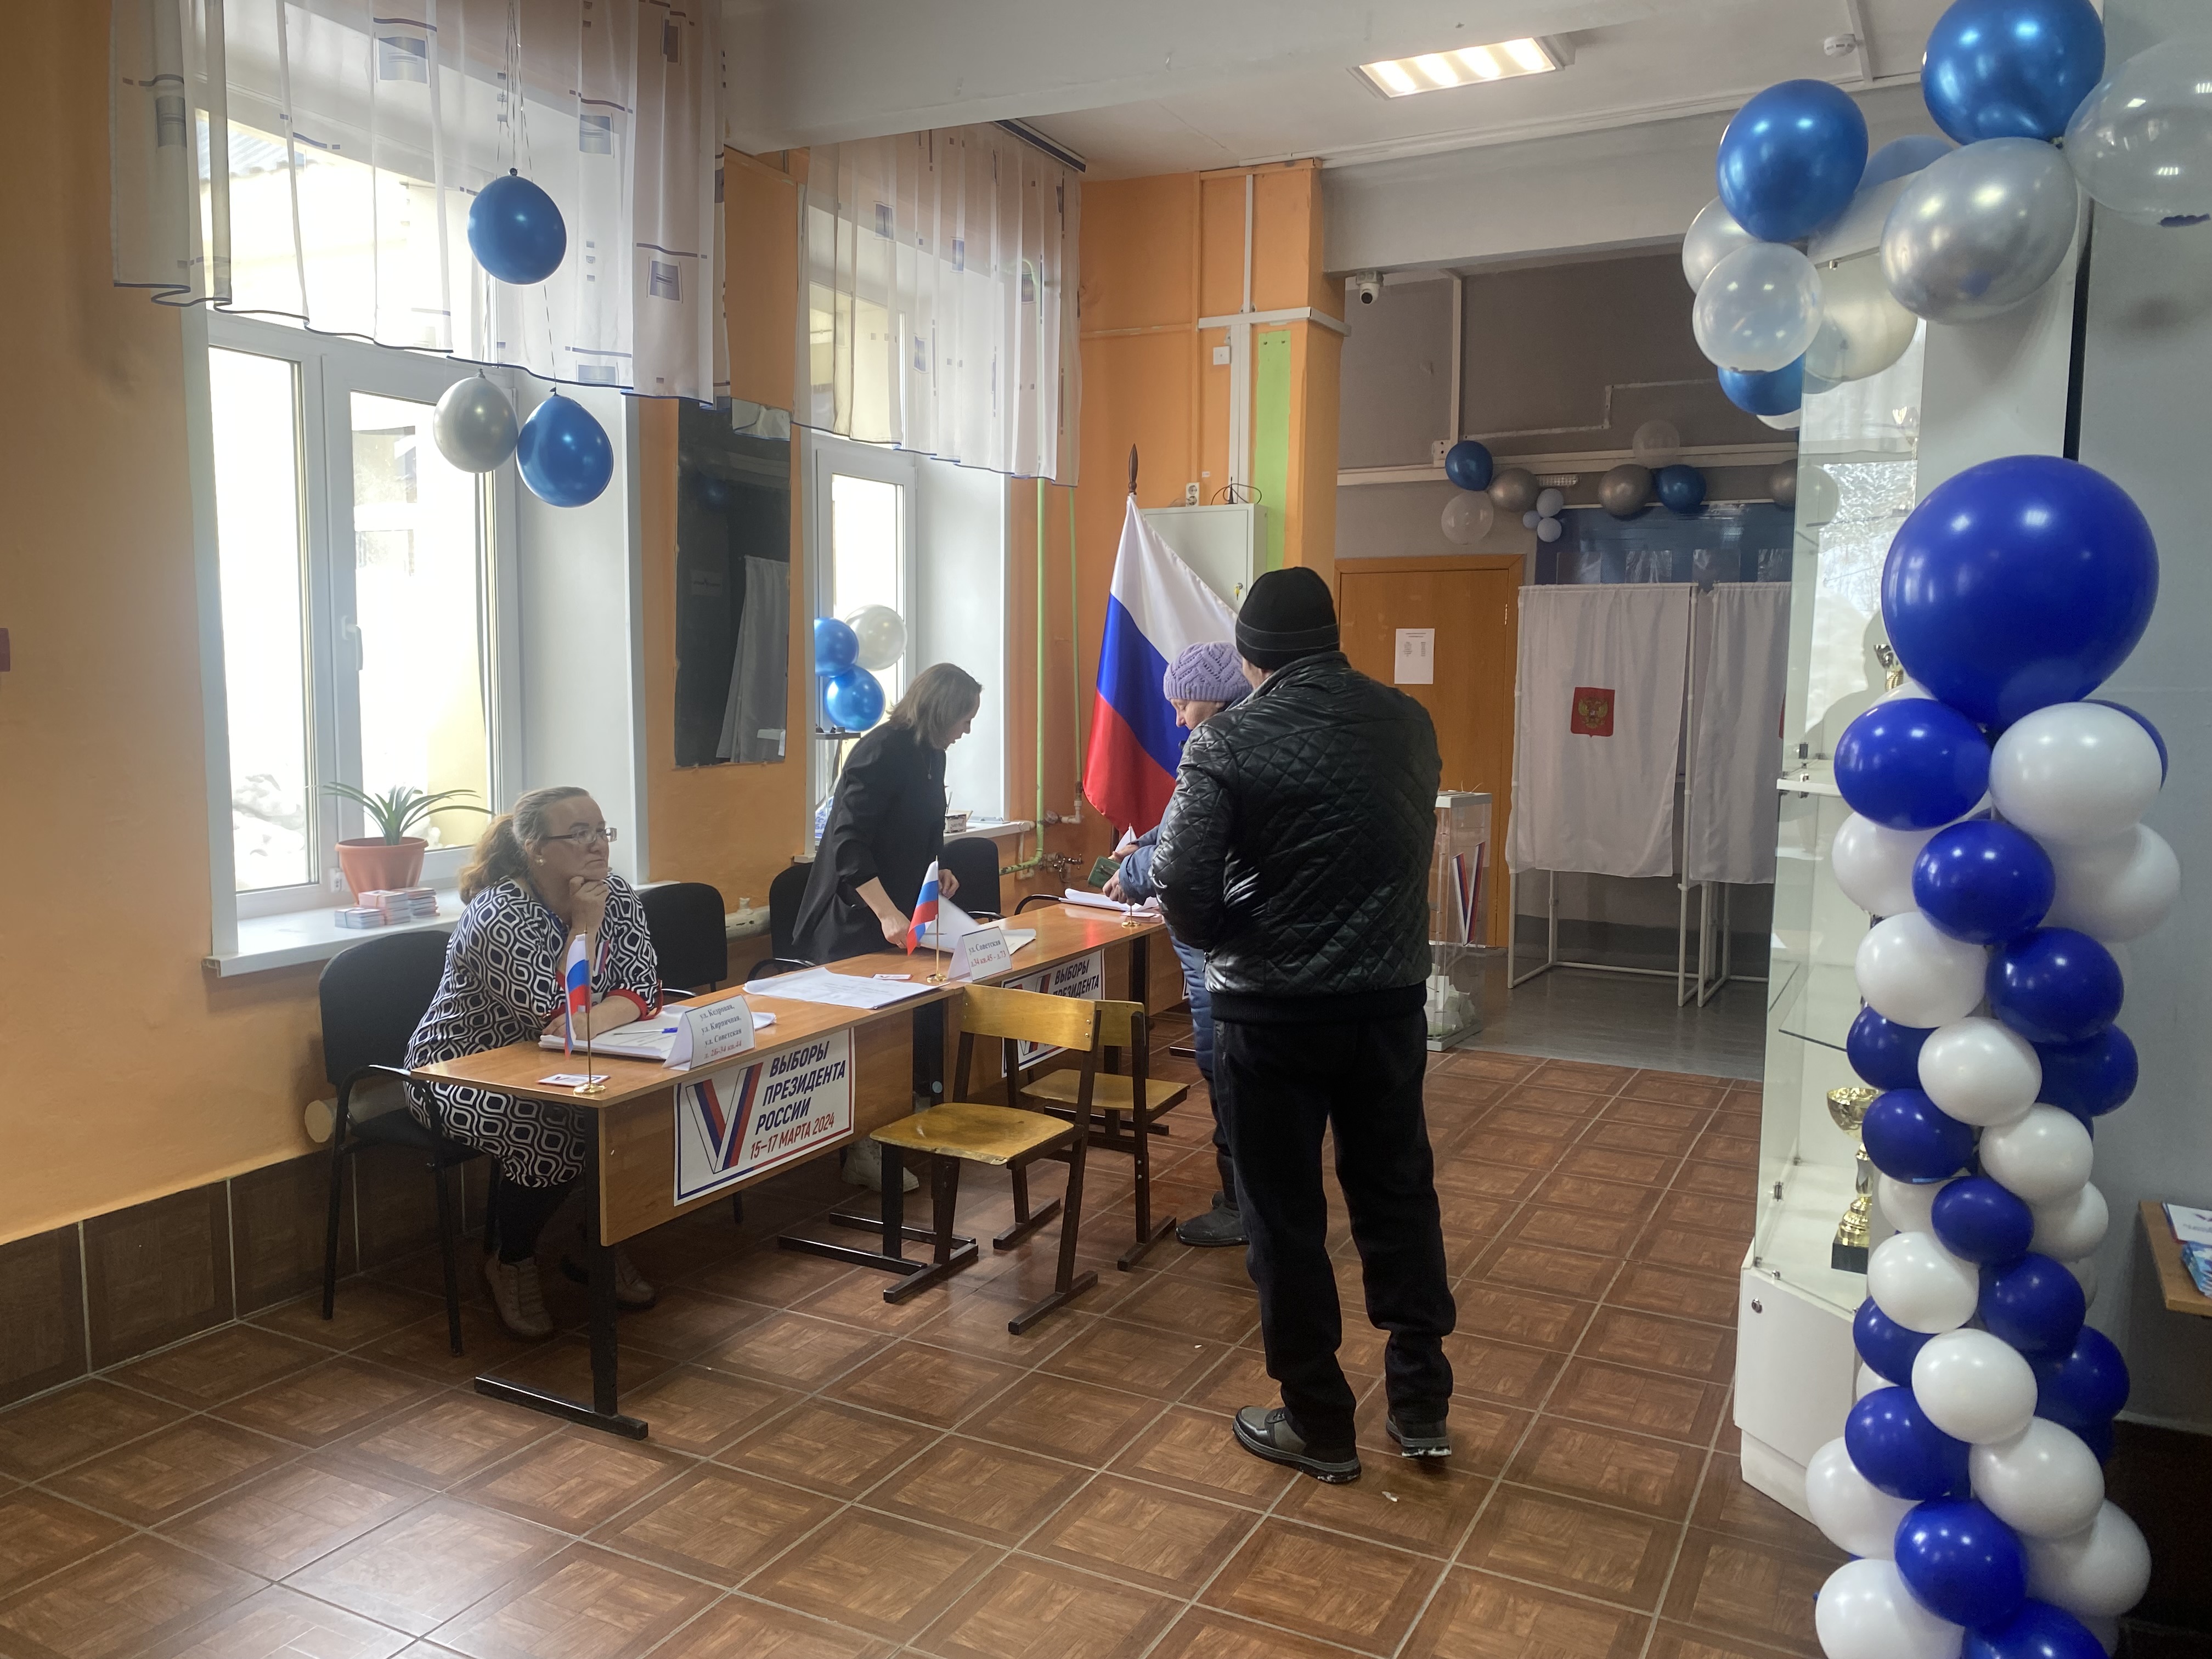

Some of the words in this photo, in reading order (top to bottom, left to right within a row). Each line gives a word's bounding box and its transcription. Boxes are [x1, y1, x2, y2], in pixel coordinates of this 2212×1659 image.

[975, 940, 1001, 951] Советская
[1054, 959, 1090, 985] ВЫБОРЫ
[714, 1028, 742, 1042] Советская
[769, 1041, 830, 1077] ВЫБОРЫ
[762, 1060, 846, 1107] ПРЕЗИДЕНТА
[755, 1097, 811, 1135] РОССИИ
[778, 1121, 811, 1149] МАРТА
[812, 1112, 835, 1136] 2024
